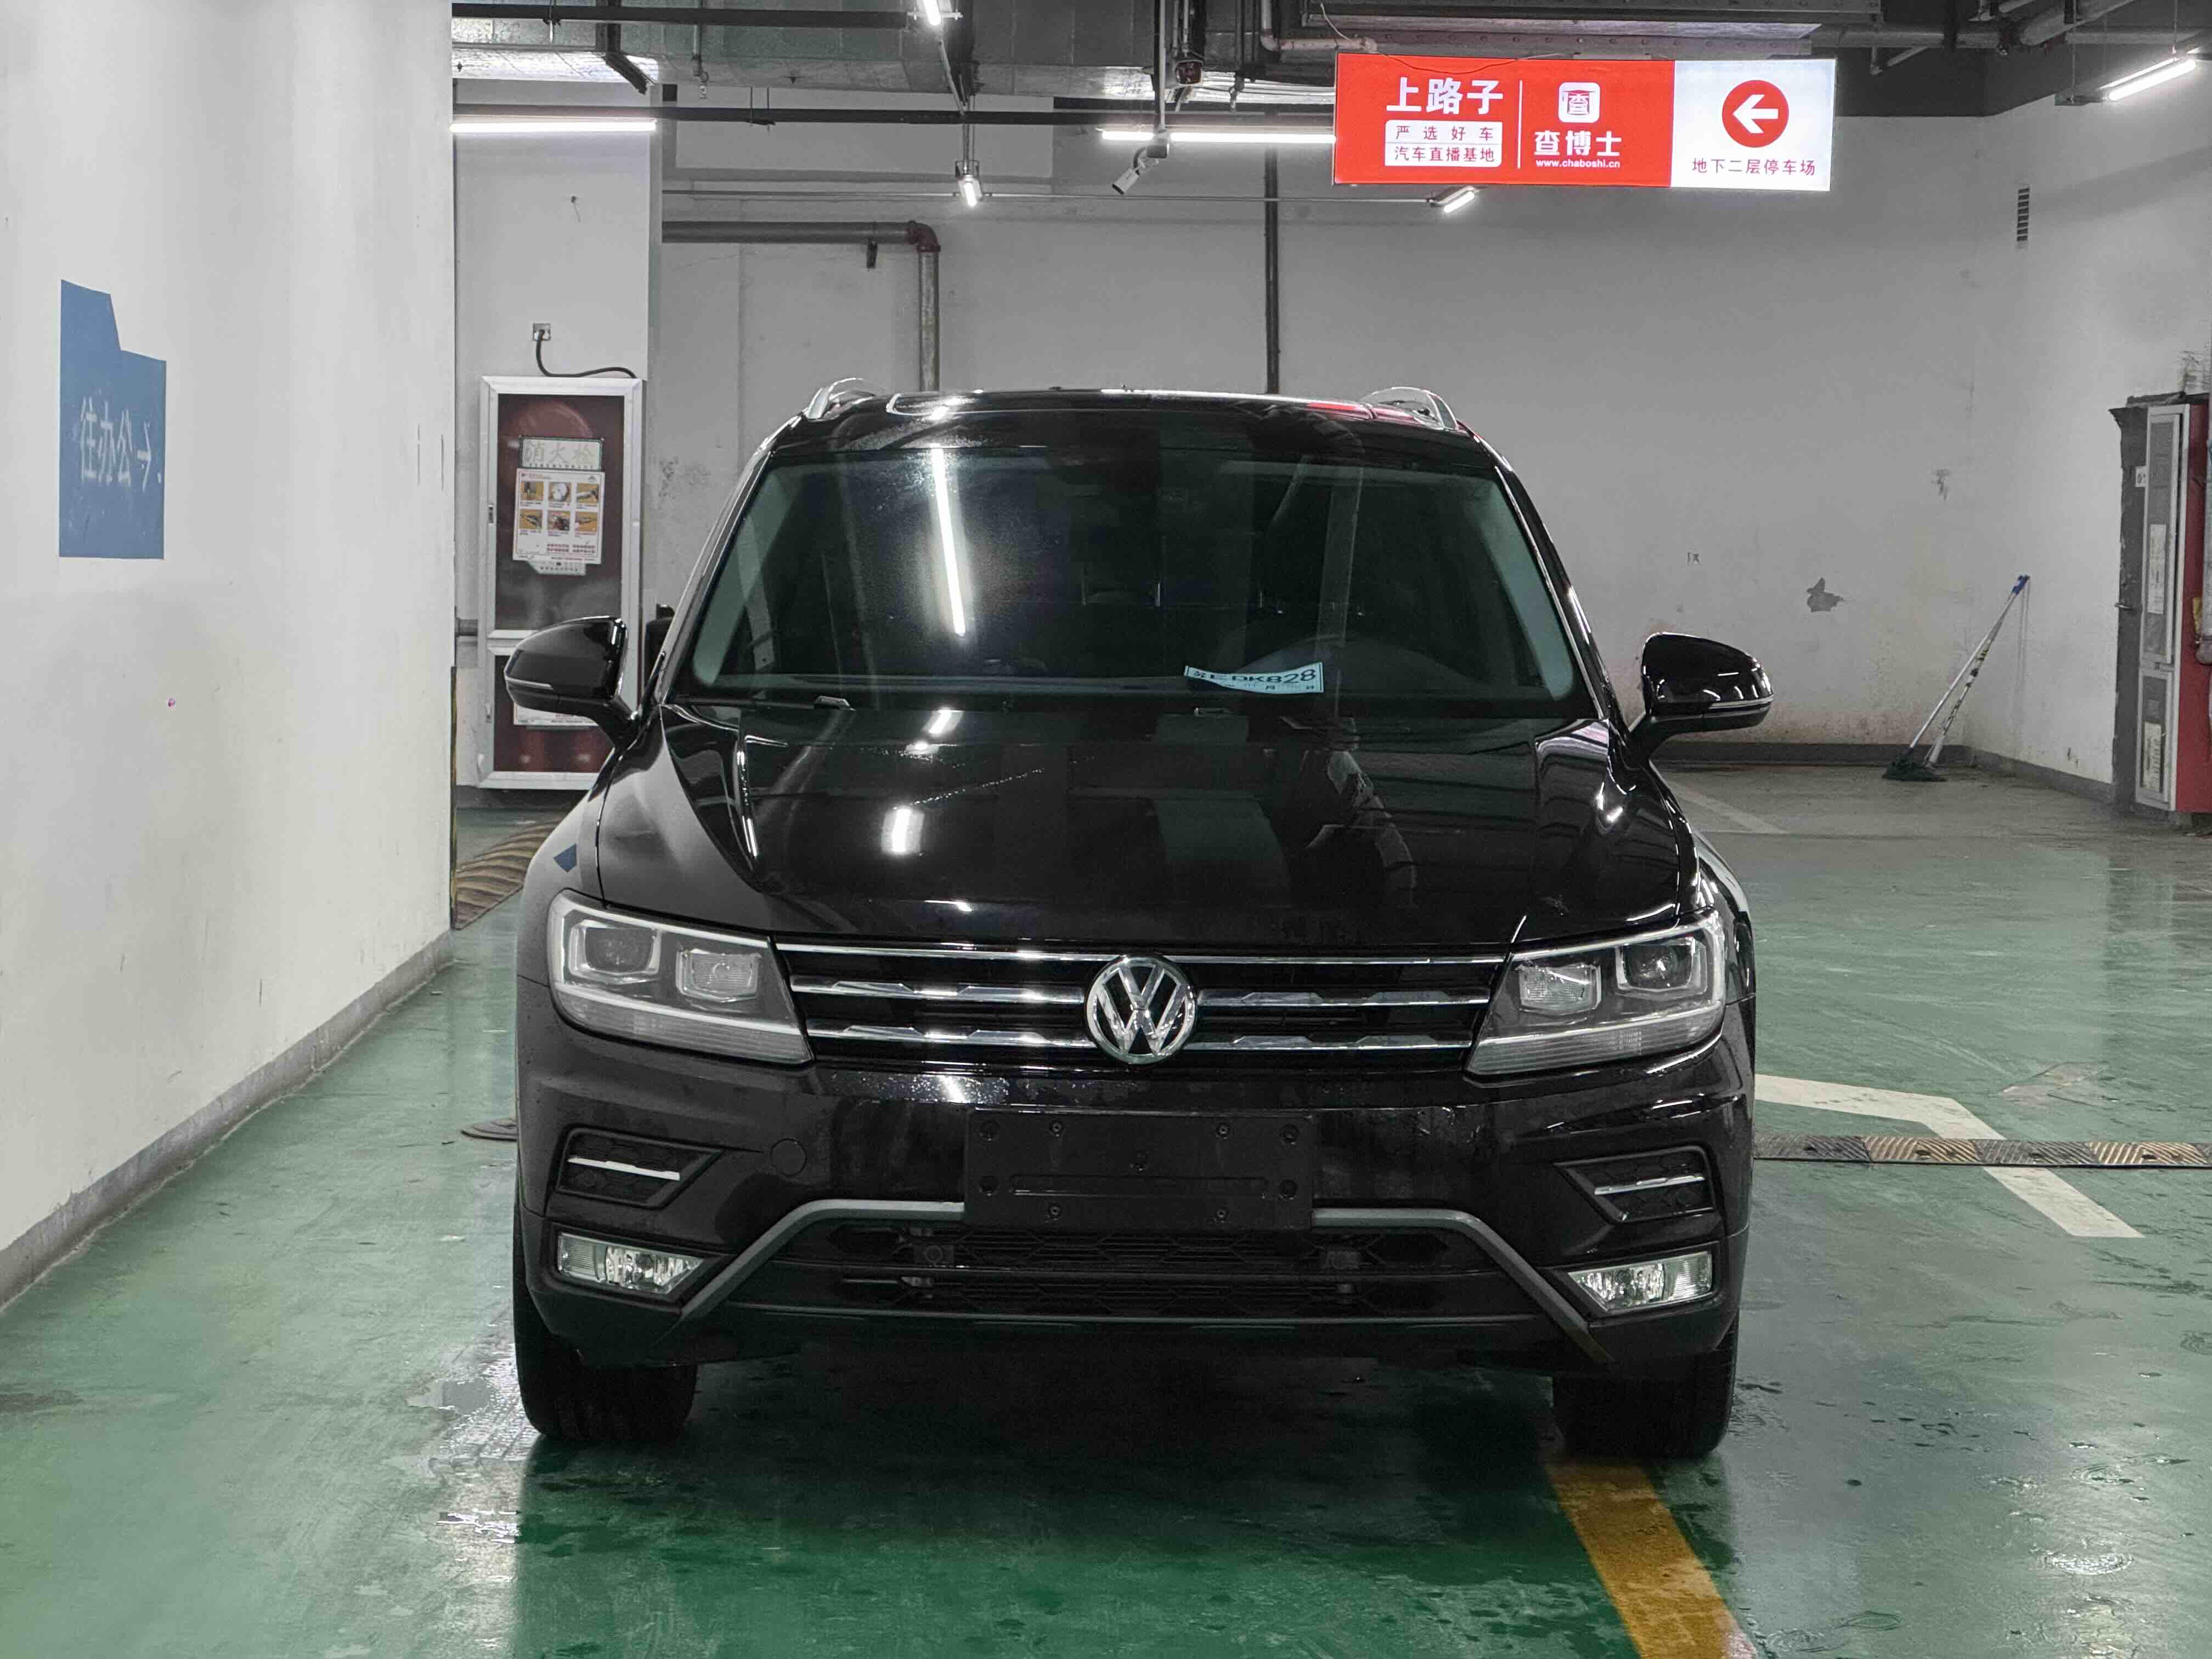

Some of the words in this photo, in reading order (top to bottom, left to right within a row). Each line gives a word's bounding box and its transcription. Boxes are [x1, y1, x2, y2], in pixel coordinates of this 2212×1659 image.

[1386, 77, 1504, 115] 上路子
[1534, 129, 1622, 157] 查博士
[1394, 145, 1495, 162] 汽车直播基地
[1536, 159, 1621, 168] www.chaboshi.cn
[1692, 157, 1816, 176] 地下二层停车场
